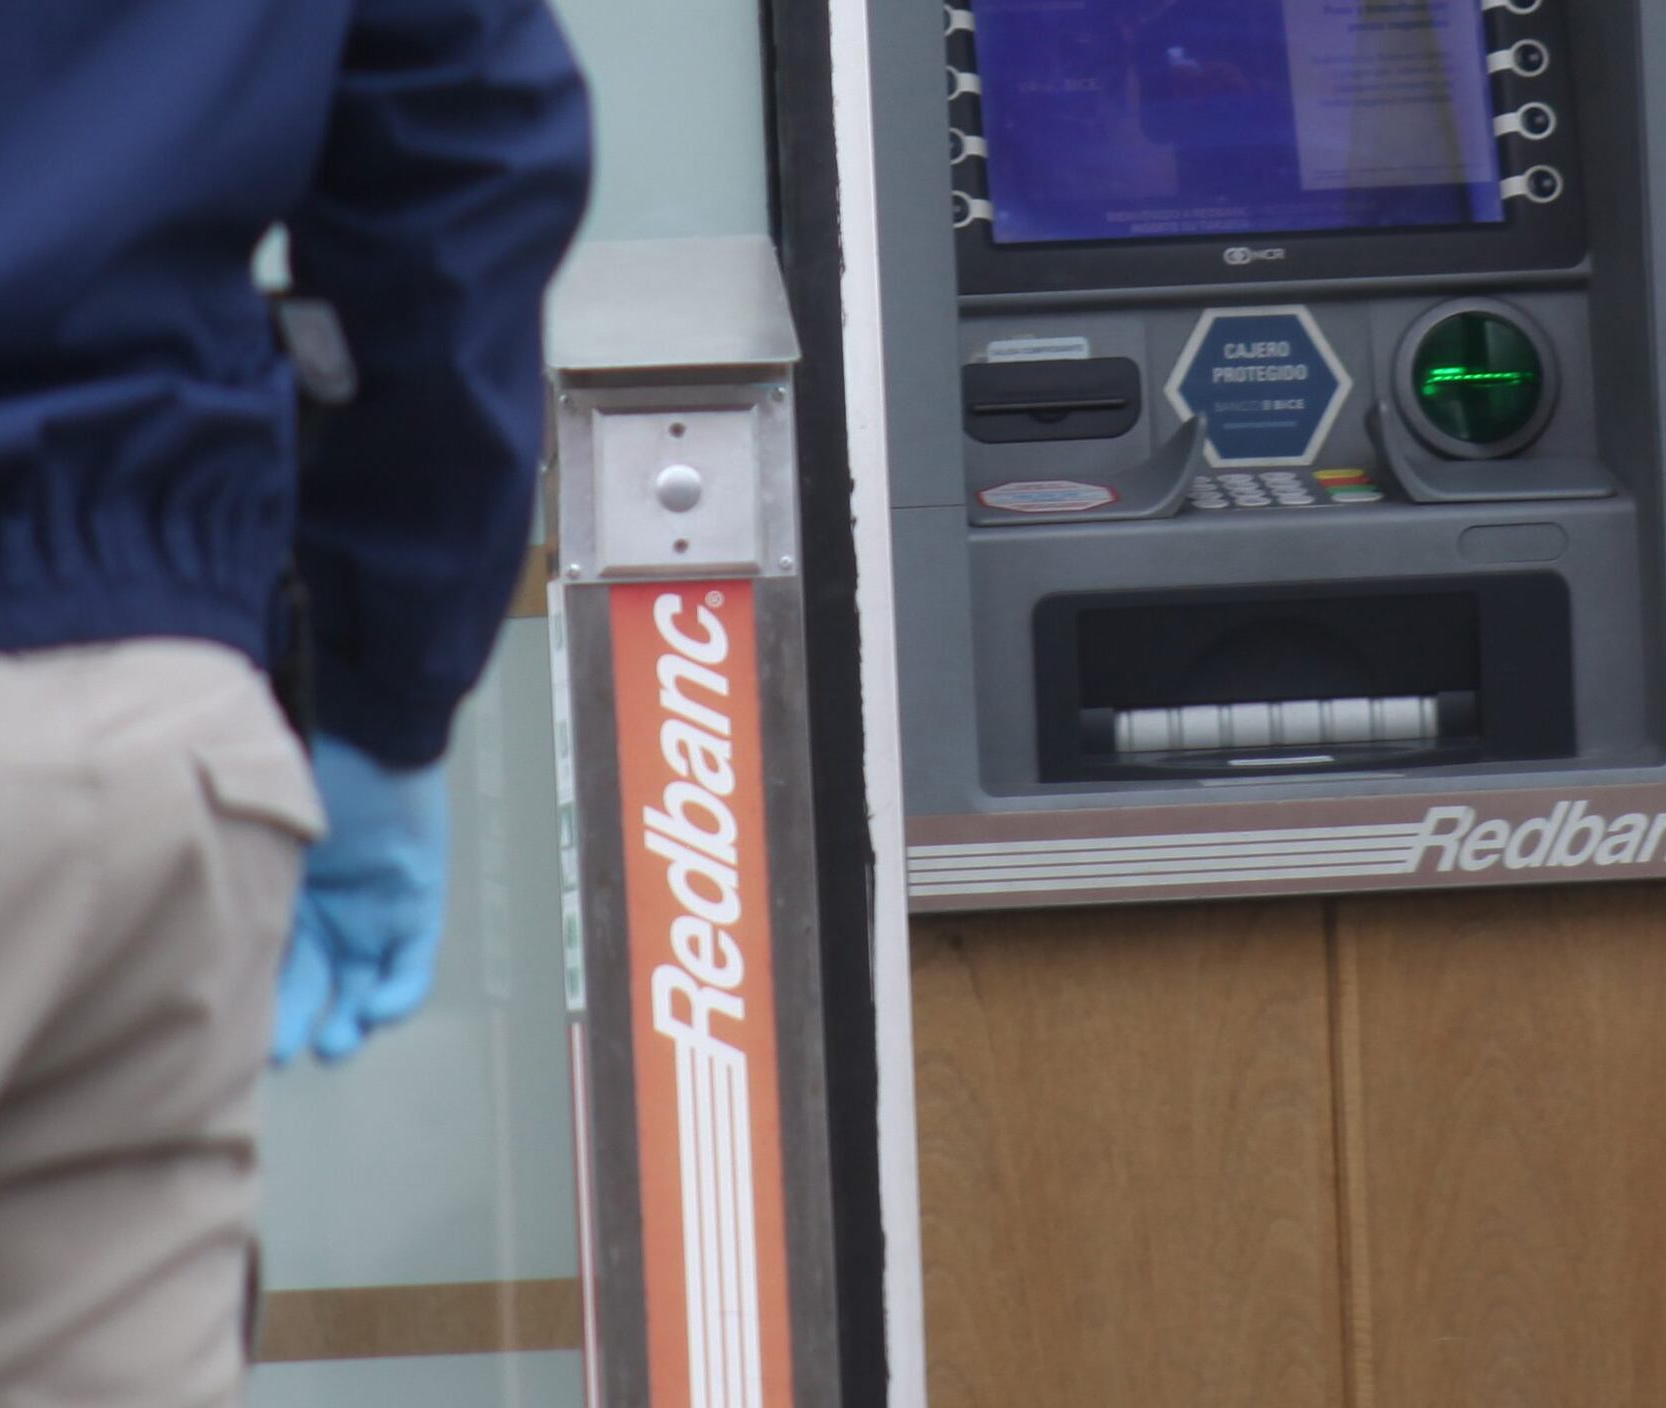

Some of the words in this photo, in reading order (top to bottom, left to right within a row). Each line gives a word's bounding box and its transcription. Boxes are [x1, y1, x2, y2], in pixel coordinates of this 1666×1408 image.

[1223, 341, 1290, 360] CAJERO
[1212, 364, 1309, 383] PROTEGIDO
[641, 592, 748, 1058] Redbanc
